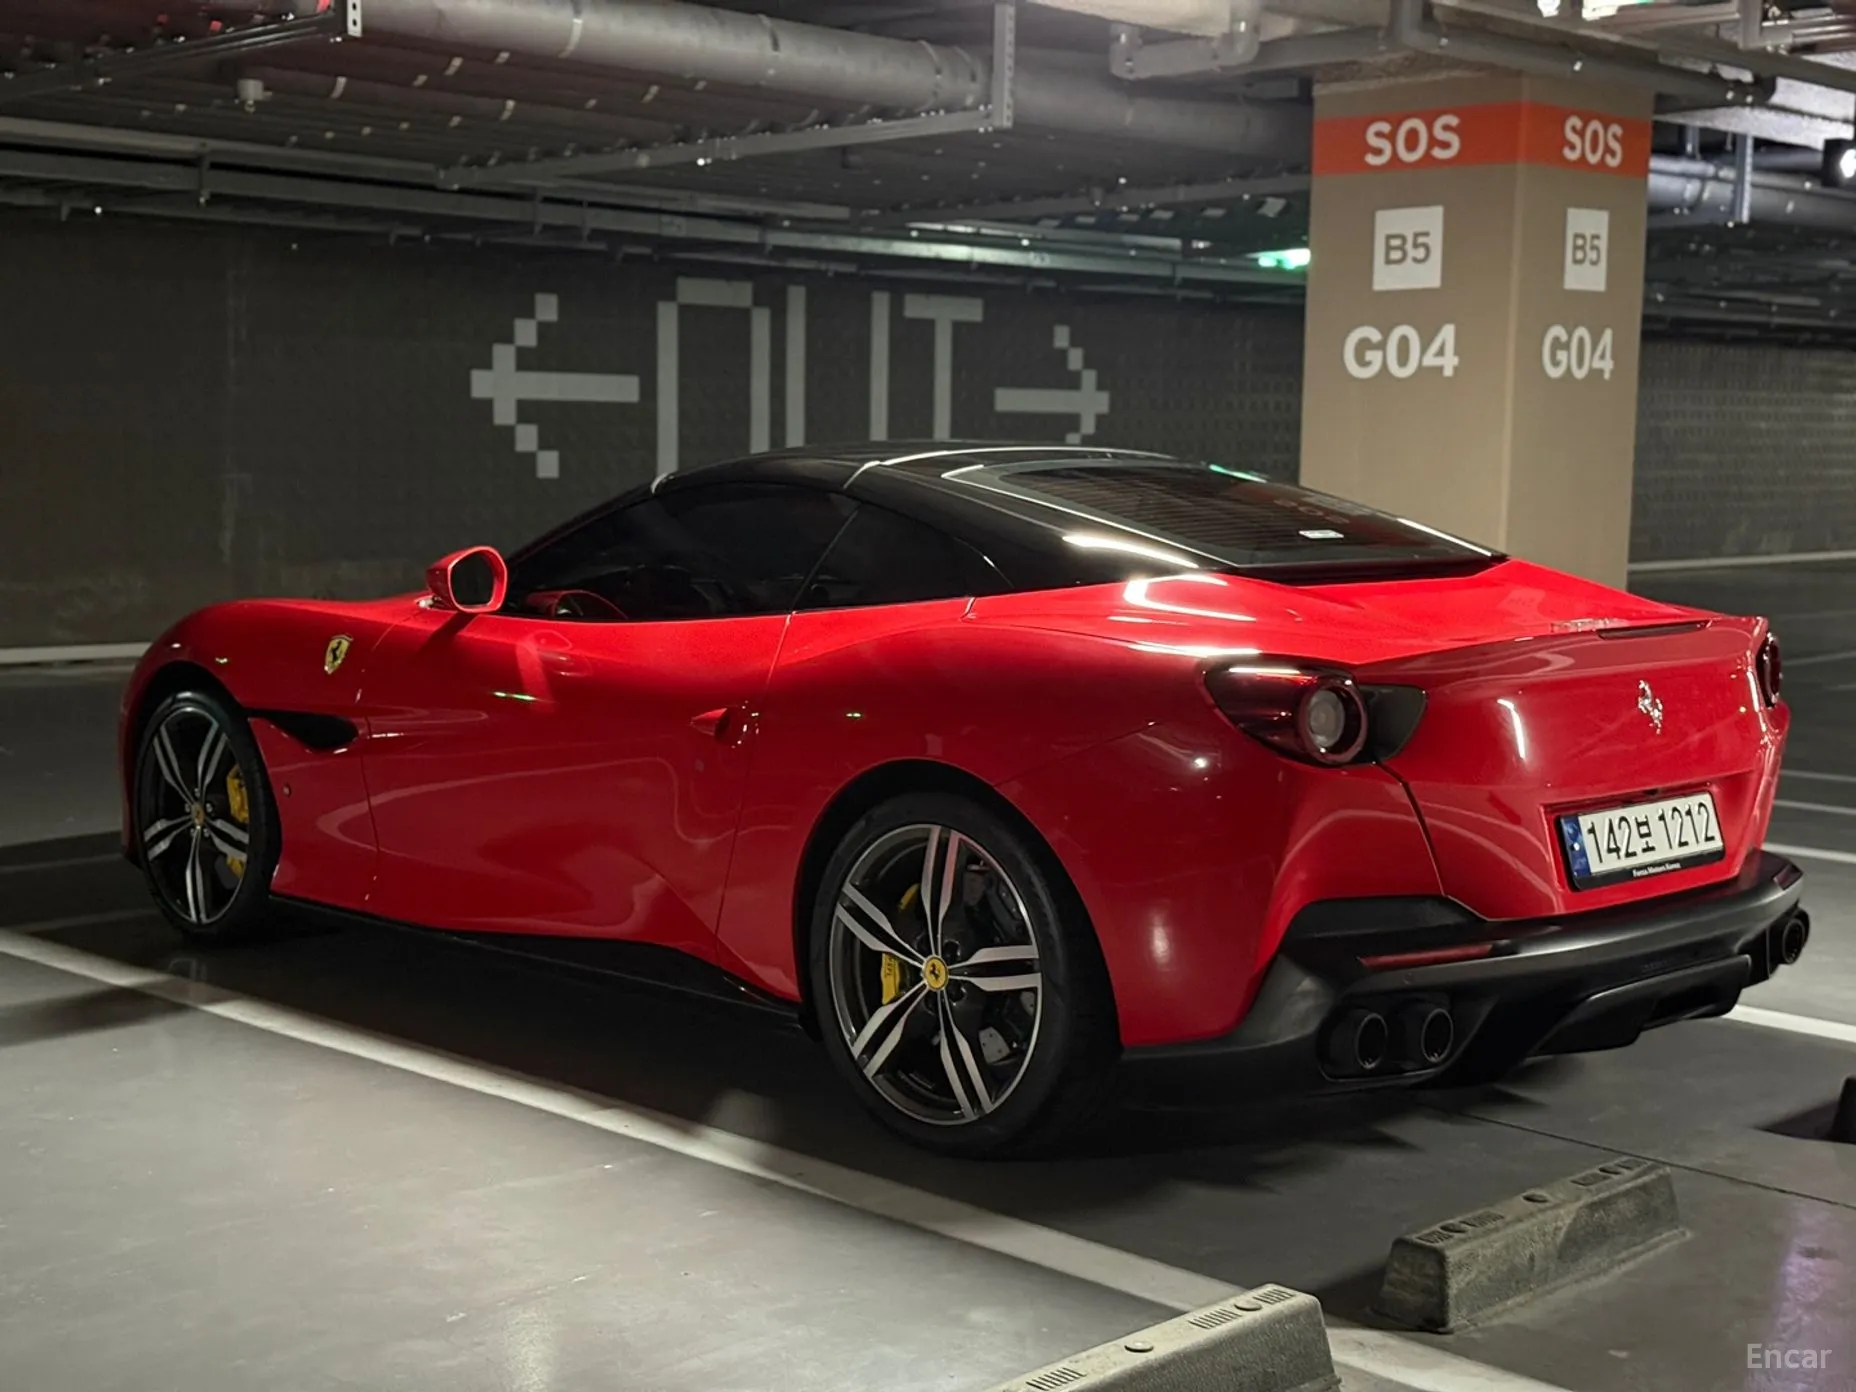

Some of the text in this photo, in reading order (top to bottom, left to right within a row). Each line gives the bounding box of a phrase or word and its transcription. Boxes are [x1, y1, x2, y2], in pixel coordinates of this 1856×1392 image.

[1364, 114, 1461, 166] SOS
[1562, 115, 1623, 167] SOS
[1384, 231, 1431, 266] B5
[1571, 232, 1601, 266] B5
[1343, 324, 1459, 379] G04
[1542, 324, 1614, 380] G04
[1587, 802, 1715, 863] 142보 1212
